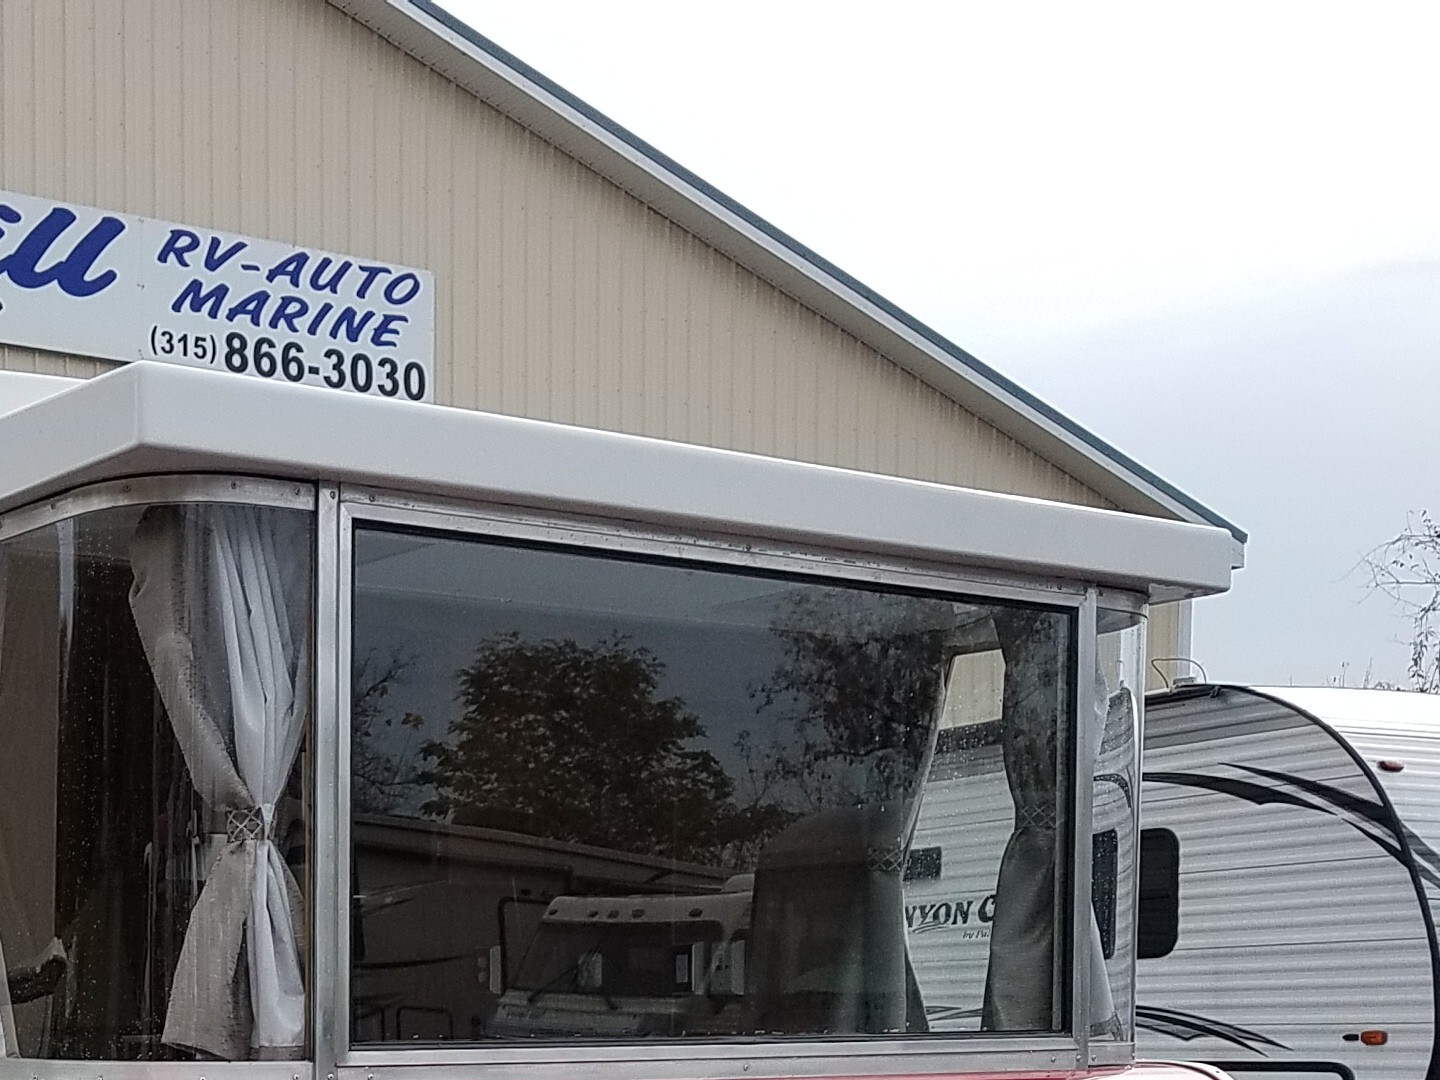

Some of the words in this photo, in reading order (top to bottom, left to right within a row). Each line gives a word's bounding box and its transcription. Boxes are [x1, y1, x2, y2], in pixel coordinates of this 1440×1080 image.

[156, 229, 422, 307] RV-AUTO
[170, 278, 410, 350] MARINE
[150, 325, 217, 366] (315)
[224, 332, 427, 401] 866-3030
